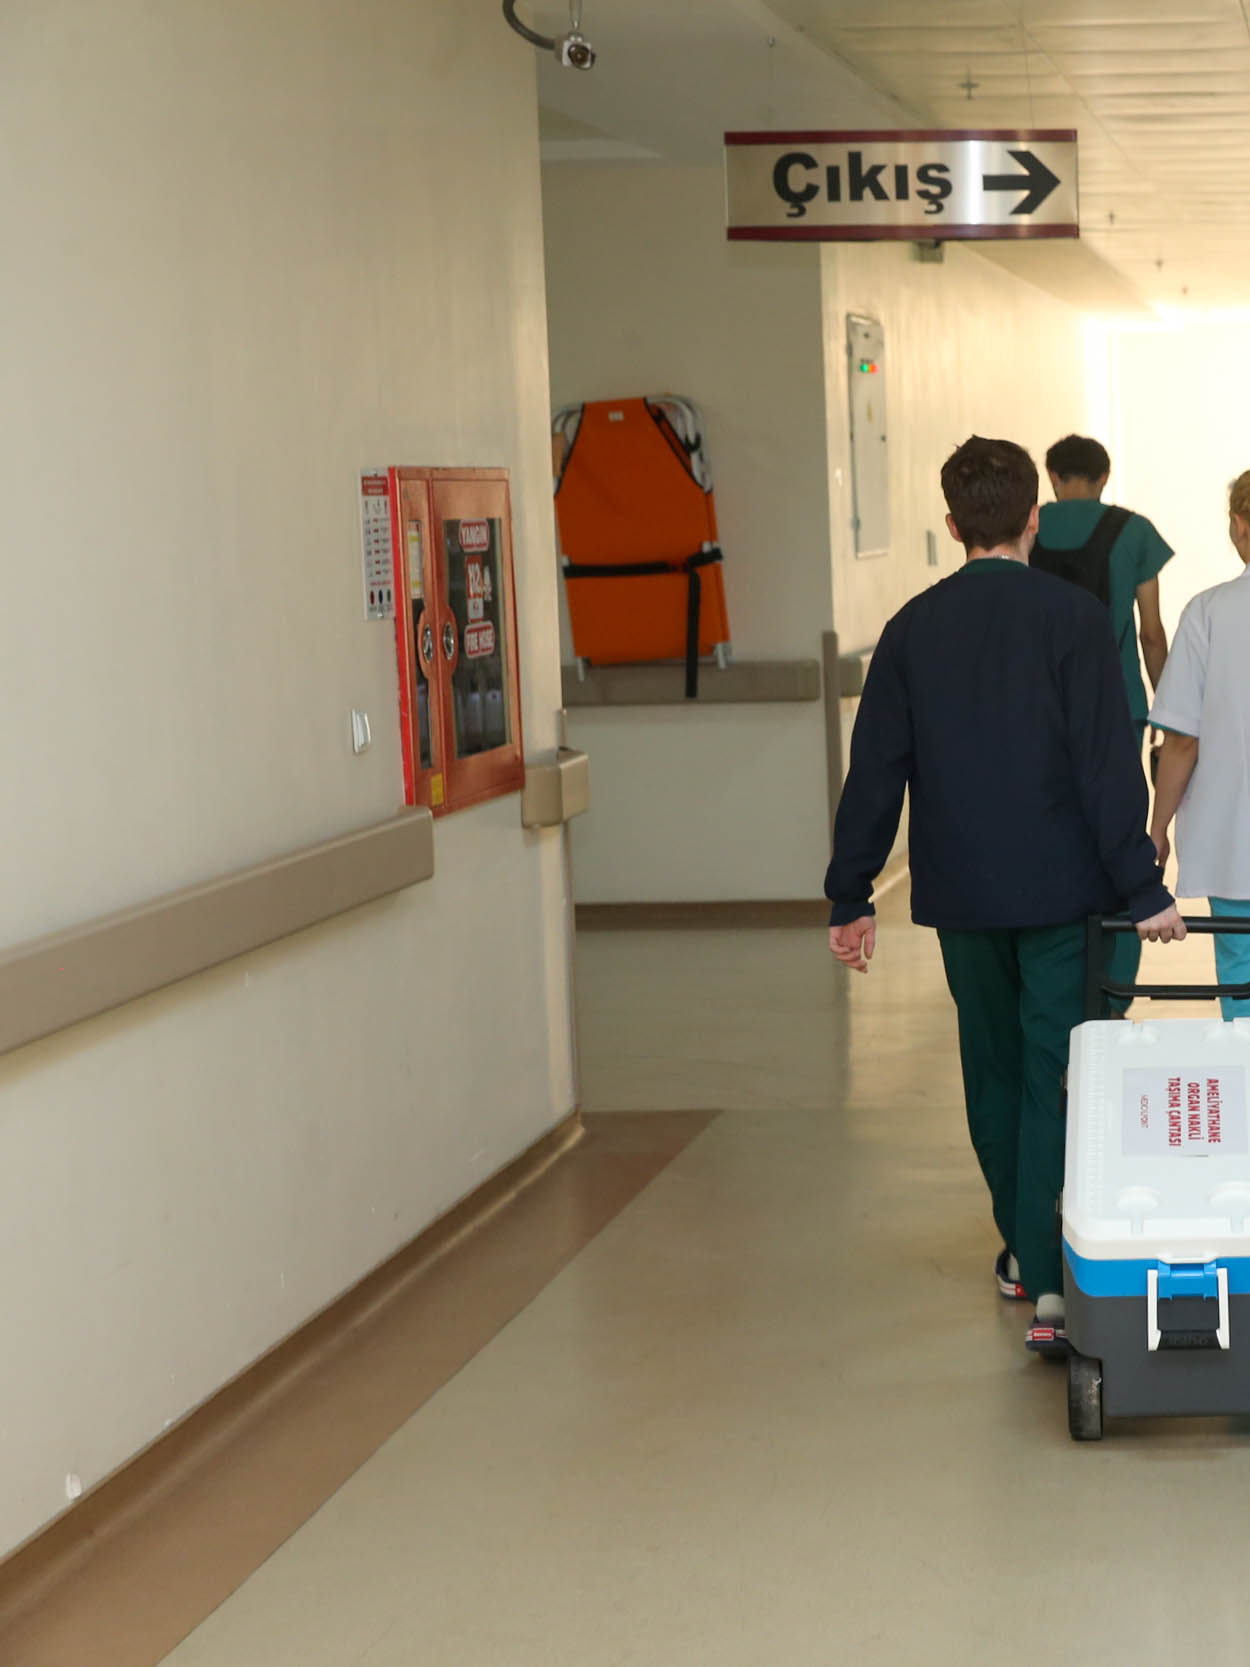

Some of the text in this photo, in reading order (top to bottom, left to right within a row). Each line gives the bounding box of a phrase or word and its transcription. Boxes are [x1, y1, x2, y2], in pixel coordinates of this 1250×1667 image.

[773, 151, 953, 217] Çıkış
[1165, 1077, 1182, 1146] TAŞIMA ÇANTASI
[1187, 1082, 1205, 1140] ORGAN NAKLİ
[1206, 1078, 1223, 1143] AMELİYATHANE
